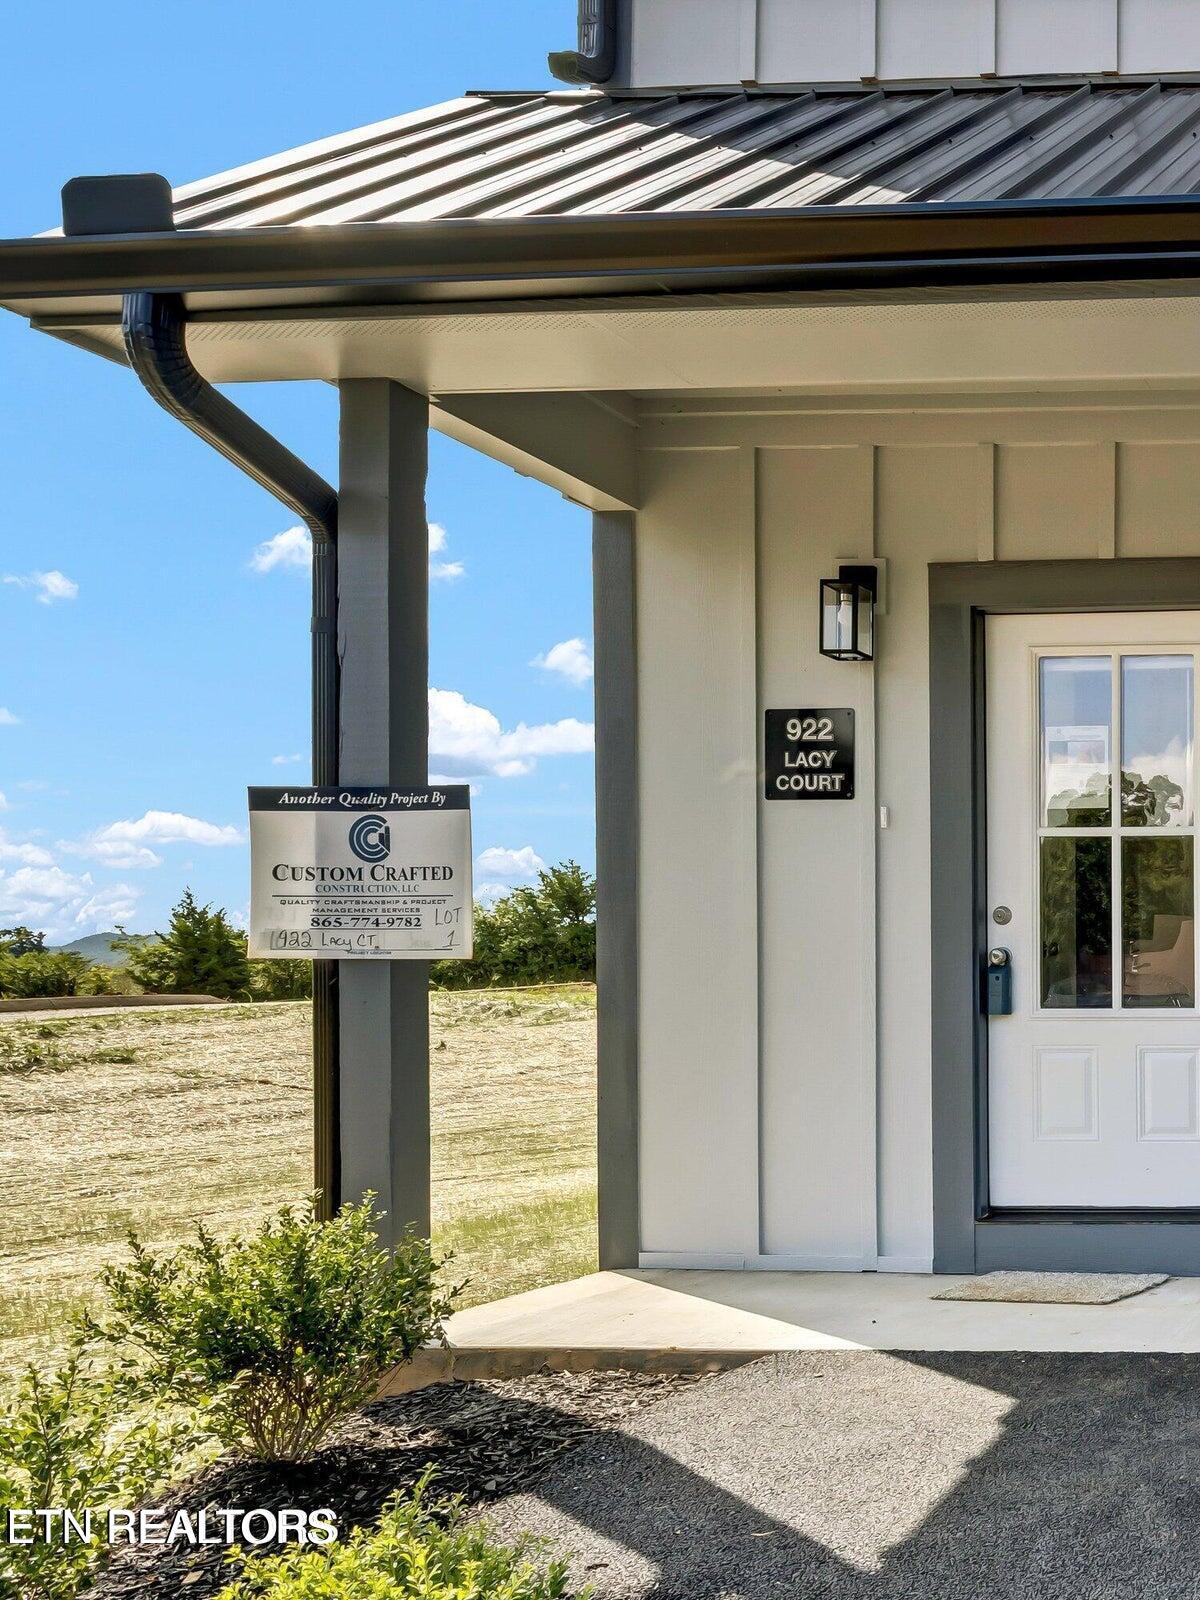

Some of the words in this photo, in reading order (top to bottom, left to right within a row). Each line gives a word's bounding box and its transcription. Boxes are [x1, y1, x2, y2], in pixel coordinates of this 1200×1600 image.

[786, 718, 834, 741] 922
[784, 750, 838, 768] LACY
[775, 773, 845, 791] COURT
[278, 792, 335, 804] Another
[339, 792, 387, 808] Quality
[389, 792, 429, 807] Project
[431, 791, 446, 807] By
[272, 863, 364, 882] CUSTOM
[370, 864, 454, 882] CRAFTED
[402, 884, 420, 893] LLC
[310, 917, 422, 927] 865-774-9782
[435, 907, 462, 926] LOT
